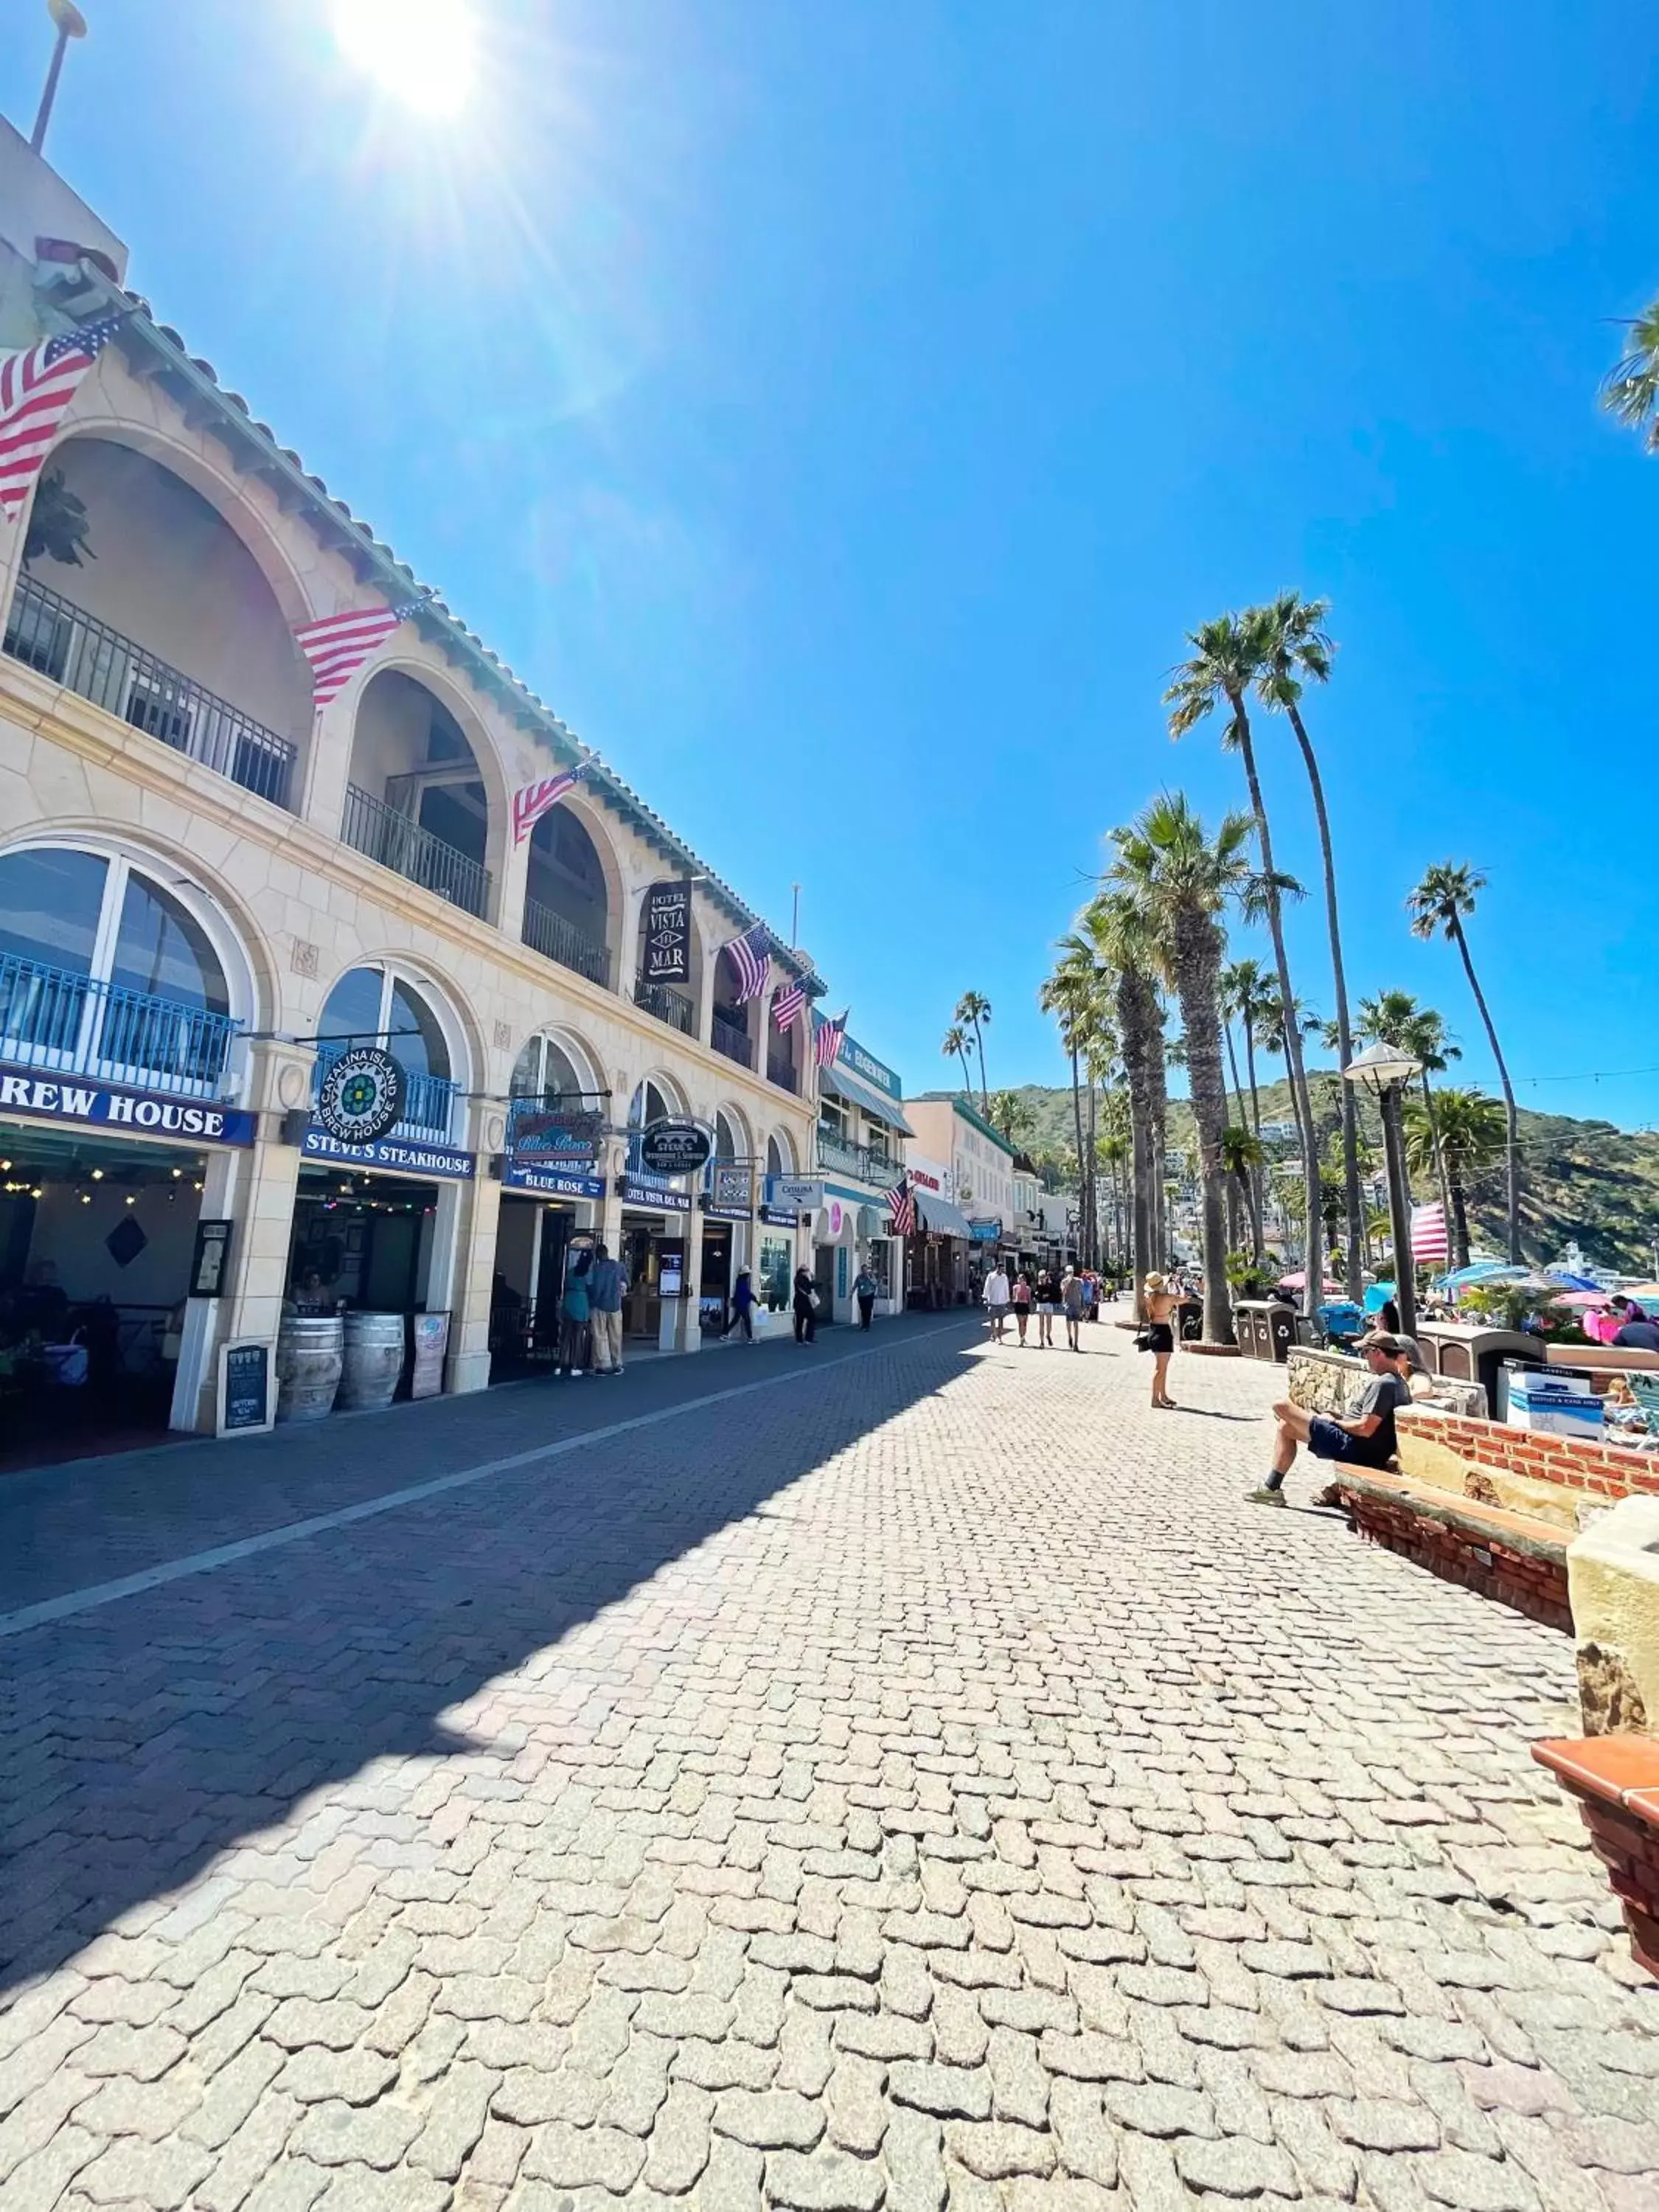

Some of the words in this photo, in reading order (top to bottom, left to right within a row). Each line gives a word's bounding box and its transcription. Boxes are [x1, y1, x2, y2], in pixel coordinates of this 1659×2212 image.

[652, 892, 686, 905] HOTEL
[650, 910, 685, 931] VISTA
[651, 948, 684, 968] MAR
[321, 1050, 367, 1104] CATALINA
[369, 1051, 397, 1097] ISLAND
[108, 1095, 224, 1137] HOUSE
[321, 1107, 351, 1139] BREW
[354, 1101, 395, 1141] HOUSE
[307, 1134, 375, 1158] STEVE'S
[379, 1147, 471, 1173] STEAKHOUSE
[525, 1174, 554, 1189] BLUE
[557, 1179, 584, 1194] ROSE
[627, 1188, 644, 1201] OTEL
